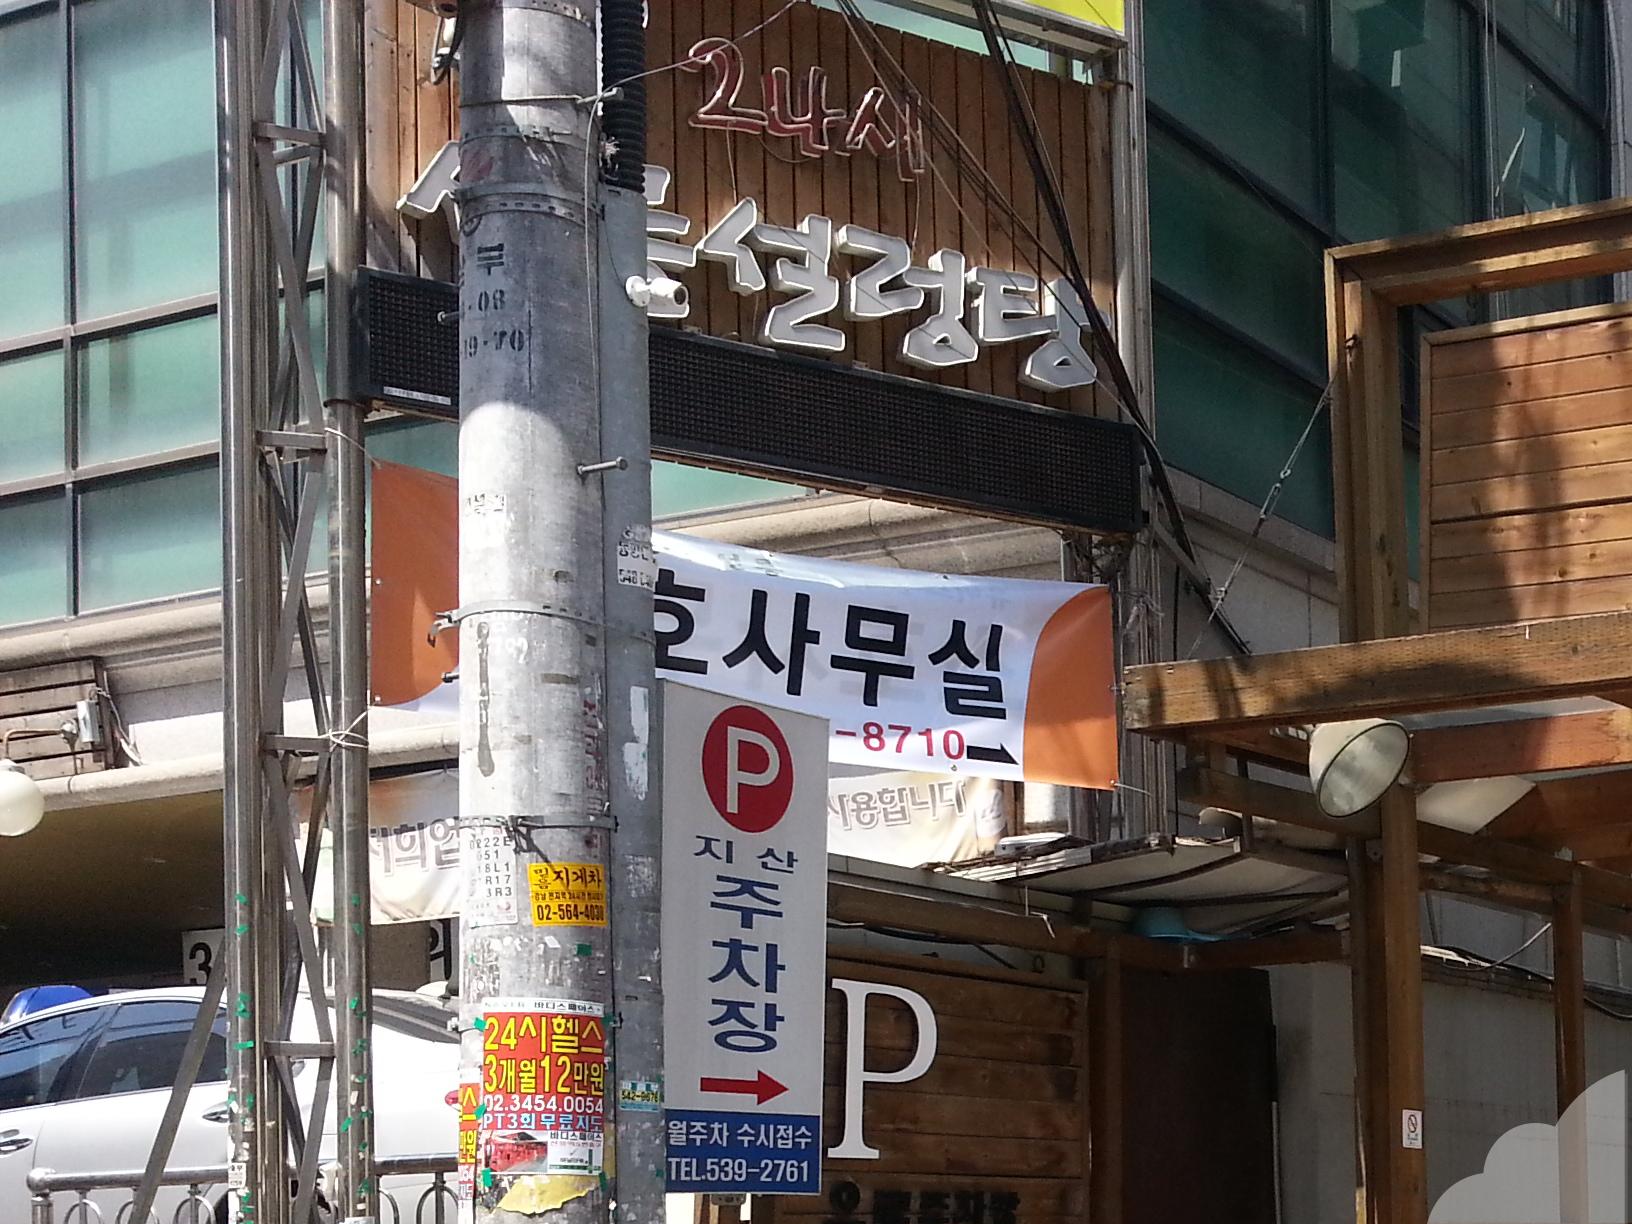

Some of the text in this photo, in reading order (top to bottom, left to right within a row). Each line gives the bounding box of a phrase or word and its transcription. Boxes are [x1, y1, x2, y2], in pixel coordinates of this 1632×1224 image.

[695, 835, 799, 874] 지산
[552, 866, 602, 890] 지게차
[708, 874, 788, 1055] 주차장
[484, 1014, 603, 1054] 24시헬스
[484, 1054, 604, 1096] 3개월12만원
[827, 978, 938, 1160] P
[484, 1094, 604, 1114] 02.3454.0054
[483, 1113, 603, 1132] PT3회 무료지도
[667, 1120, 813, 1150] 월주차 수시접수
[667, 1158, 810, 1183] TEL.539-2761
